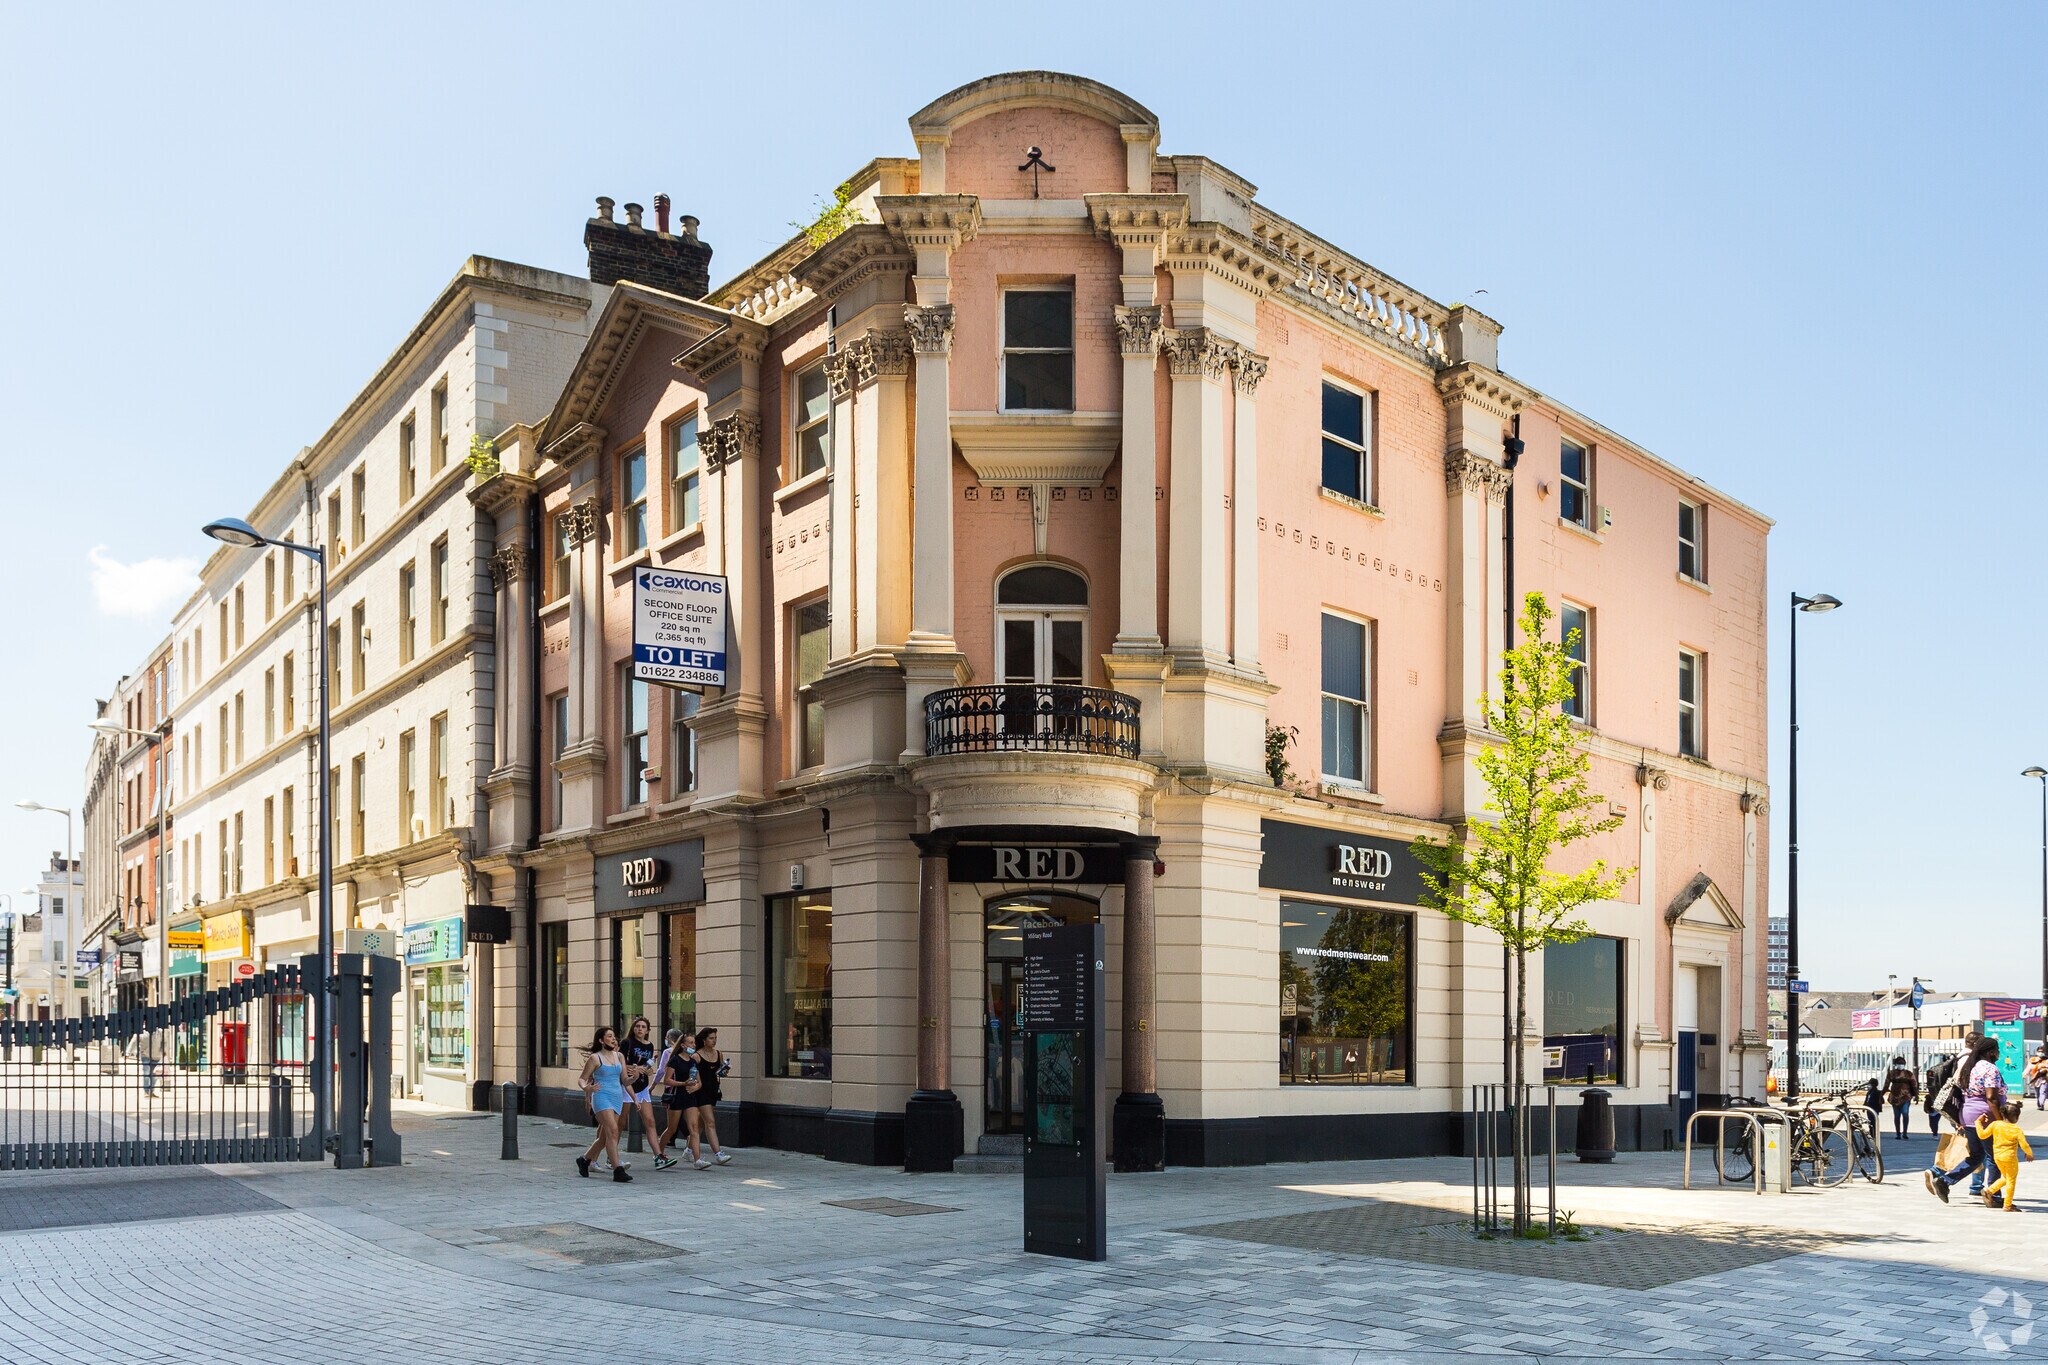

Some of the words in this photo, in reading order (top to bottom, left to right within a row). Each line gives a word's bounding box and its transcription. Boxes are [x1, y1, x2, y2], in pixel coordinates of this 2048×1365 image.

[651, 586, 683, 596] Commercial
[652, 575, 722, 594] caxtons
[644, 598, 684, 611] SECOND
[686, 603, 718, 614] FLOOR
[649, 610, 683, 621] OFFICE
[686, 614, 713, 625] SUITE
[661, 622, 677, 631] 220
[679, 625, 690, 633] sq
[655, 632, 682, 642] (2,365
[684, 636, 695, 645] sq
[697, 636, 707, 646] ft)
[645, 646, 674, 664] TO
[679, 650, 716, 668] LET
[641, 665, 675, 678] 01622
[678, 669, 719, 683] 234886
[992, 847, 1085, 880] RED
[1338, 844, 1392, 878] RED
[622, 857, 656, 886] RED
[1332, 877, 1386, 891] menswear
[627, 886, 663, 898] menswear
[471, 932, 493, 941] RED
[1296, 946, 1389, 962] www.redmenswear.com
[1547, 990, 1575, 1005] RED
